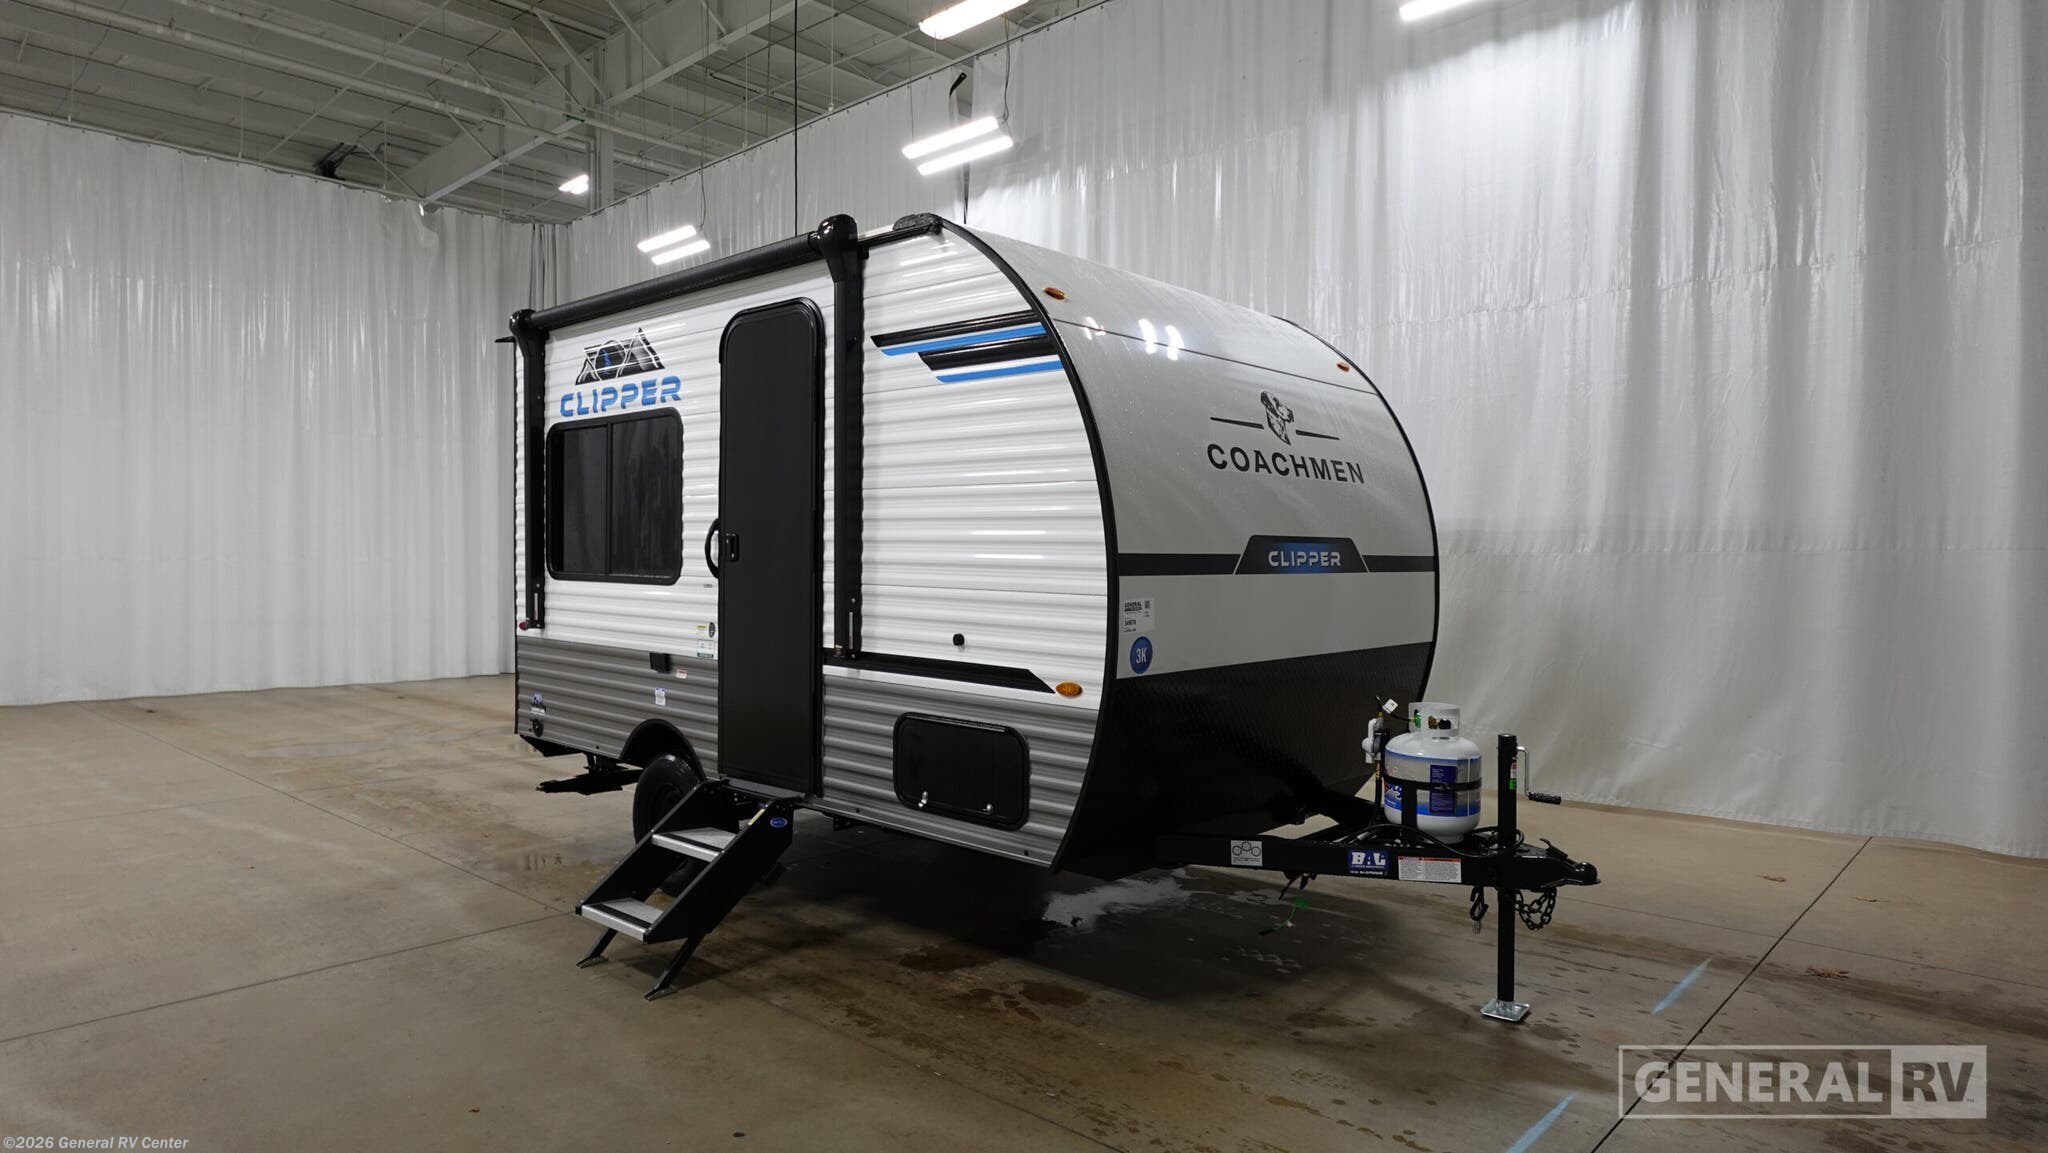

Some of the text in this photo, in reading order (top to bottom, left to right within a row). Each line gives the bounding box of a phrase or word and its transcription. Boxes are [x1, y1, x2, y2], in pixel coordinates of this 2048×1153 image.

[560, 376, 682, 417] CLIPPER
[1207, 443, 1365, 484] COACHMEN
[1268, 550, 1341, 568] CLIPPER
[1135, 647, 1147, 664] 3K
